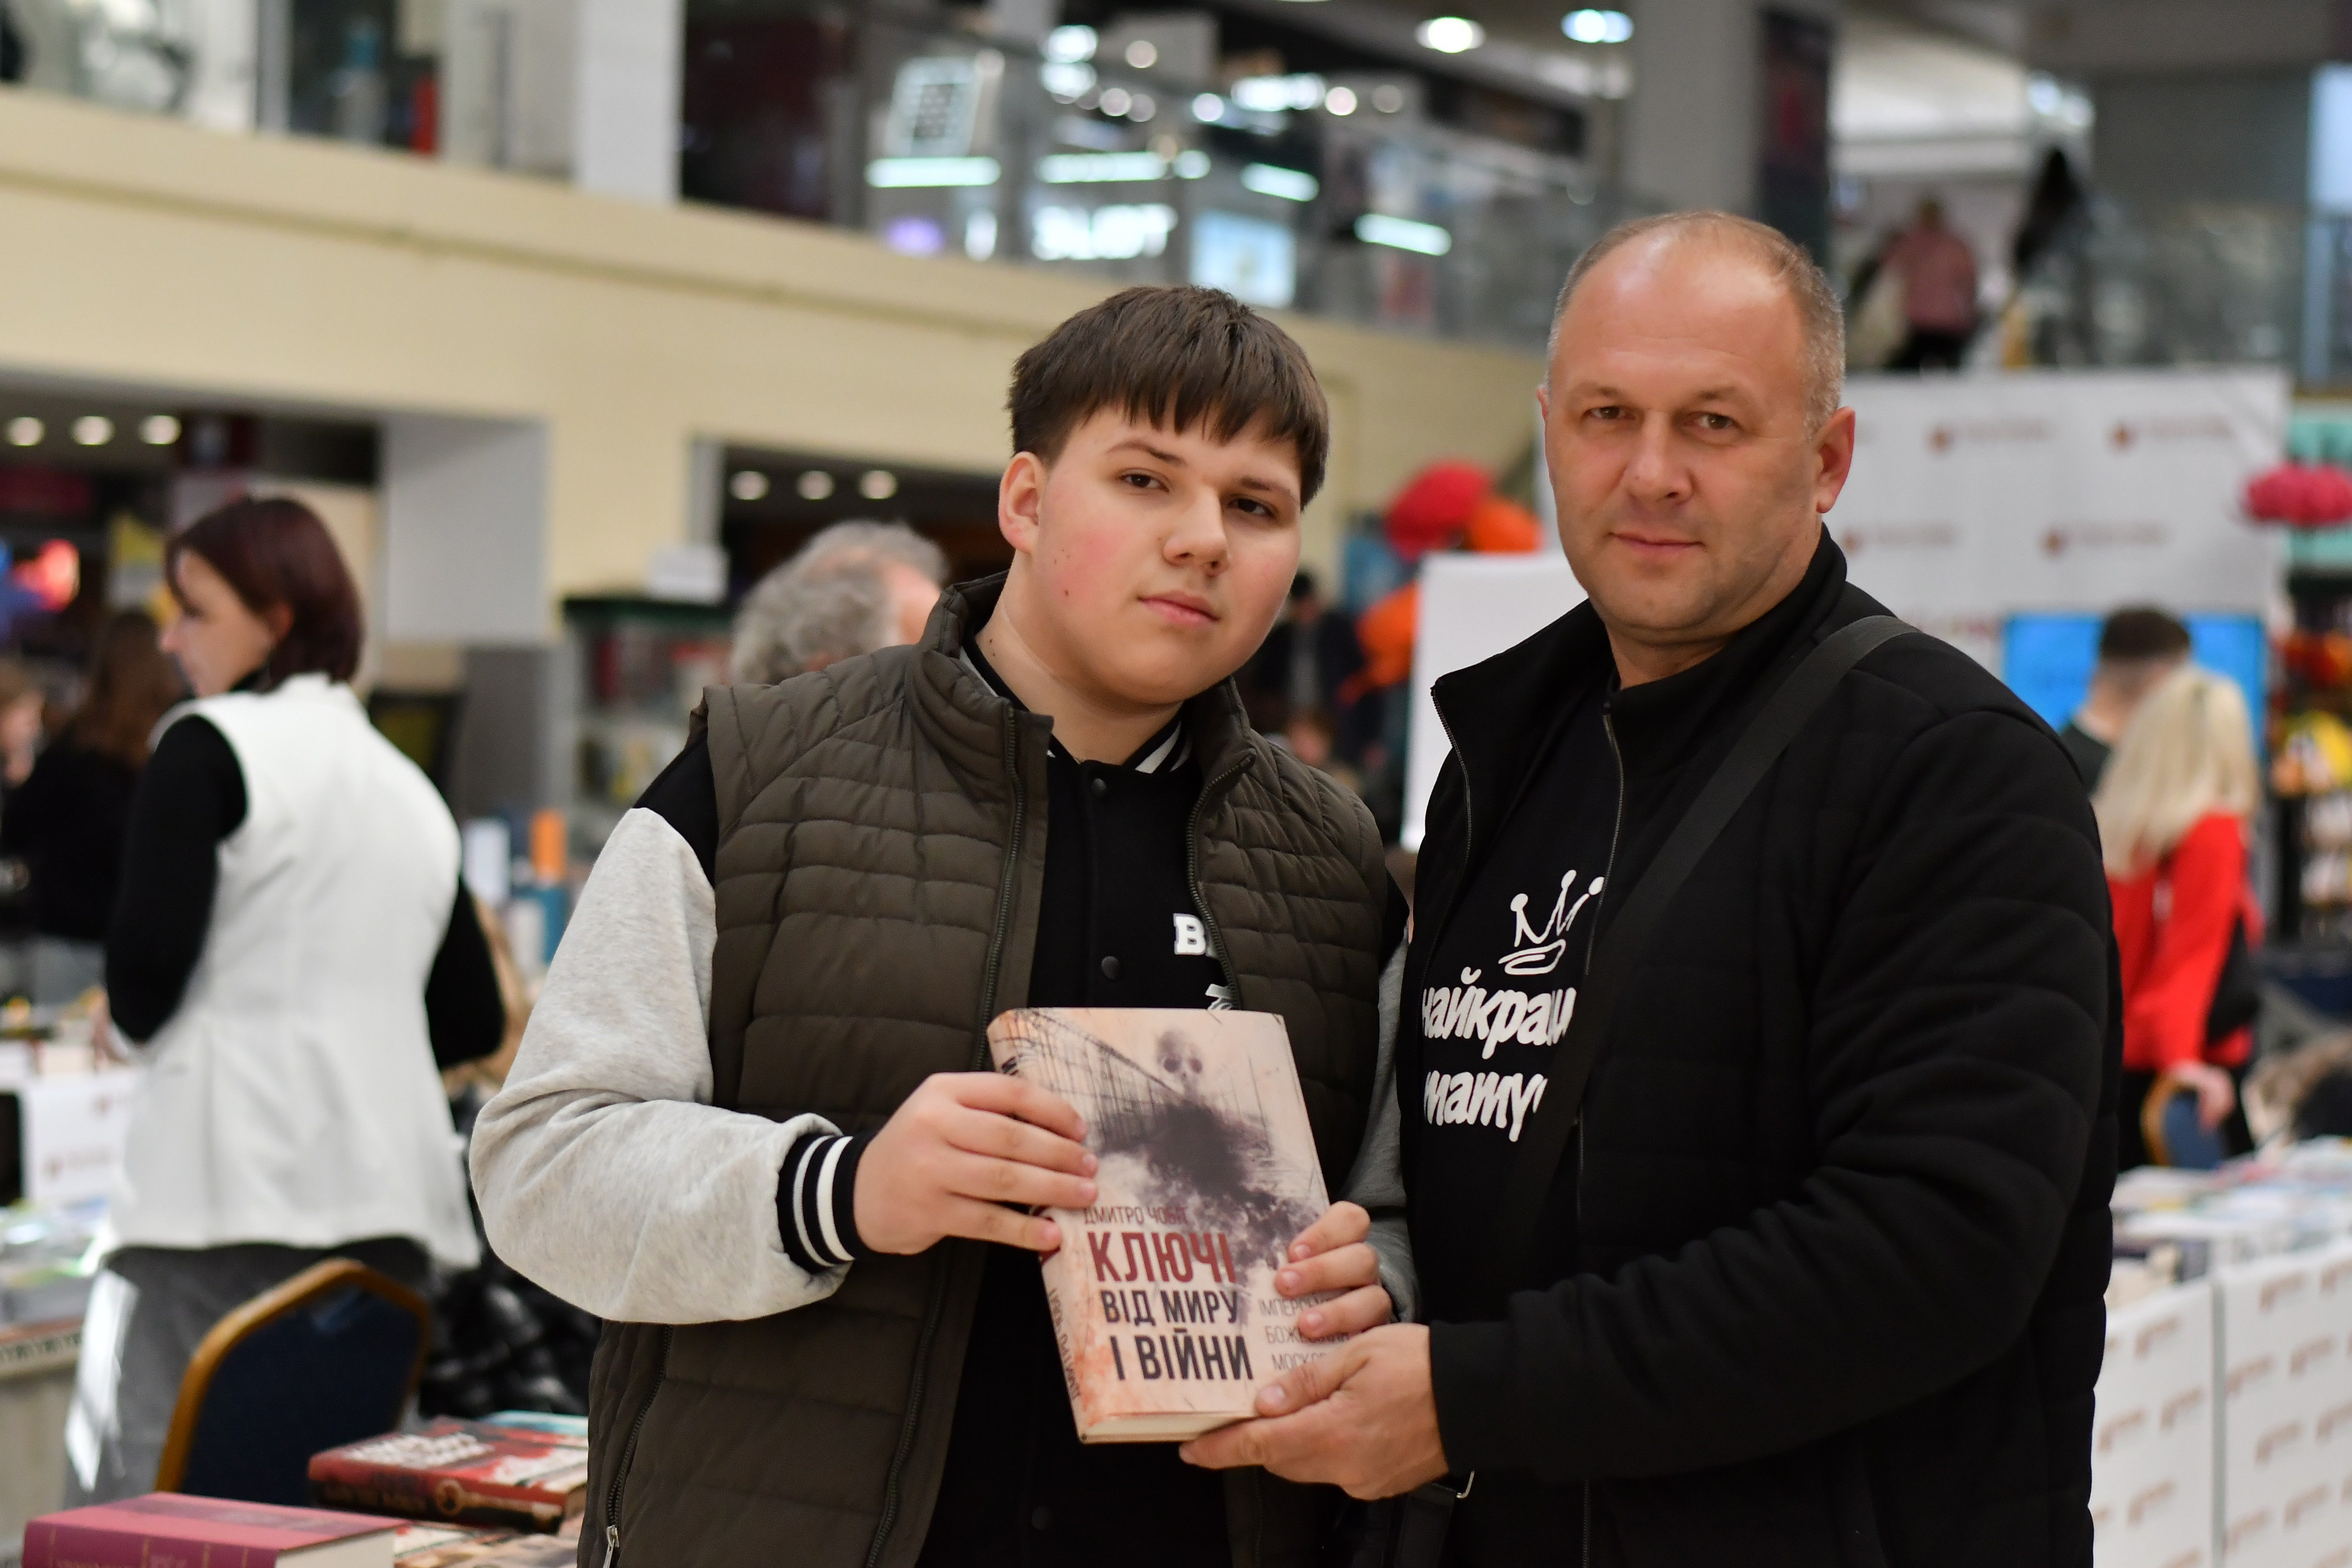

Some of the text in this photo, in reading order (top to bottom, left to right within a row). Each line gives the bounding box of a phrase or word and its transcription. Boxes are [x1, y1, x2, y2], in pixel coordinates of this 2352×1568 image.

[1085, 1205, 1145, 1225] ДМИТРО
[1087, 1231, 1237, 1284] КЛЮЧІ
[1101, 1290, 1237, 1326] ВІД МИРУ
[1110, 1327, 1254, 1380] І ВІЙНИ
